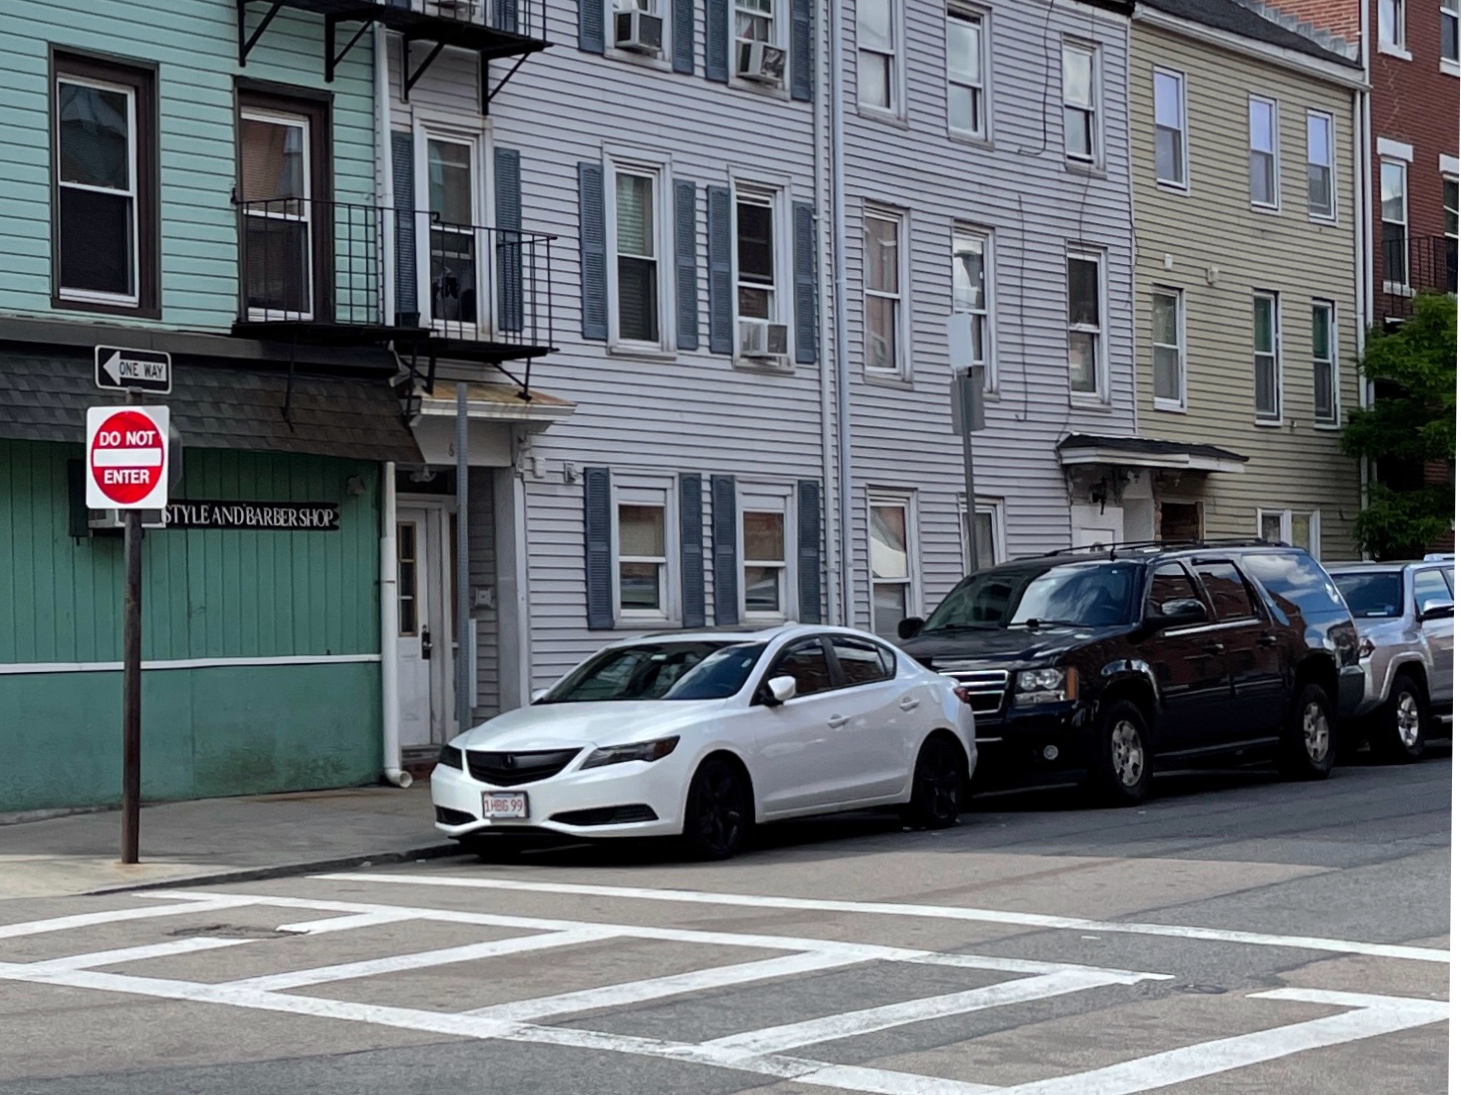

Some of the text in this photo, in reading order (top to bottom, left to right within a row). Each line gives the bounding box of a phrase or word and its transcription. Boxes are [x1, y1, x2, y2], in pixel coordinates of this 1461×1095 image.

[119, 361, 164, 379] ONE WAY
[99, 430, 156, 447] DO NOT
[104, 469, 150, 485] ENTER
[510, 799, 523, 812] 99
